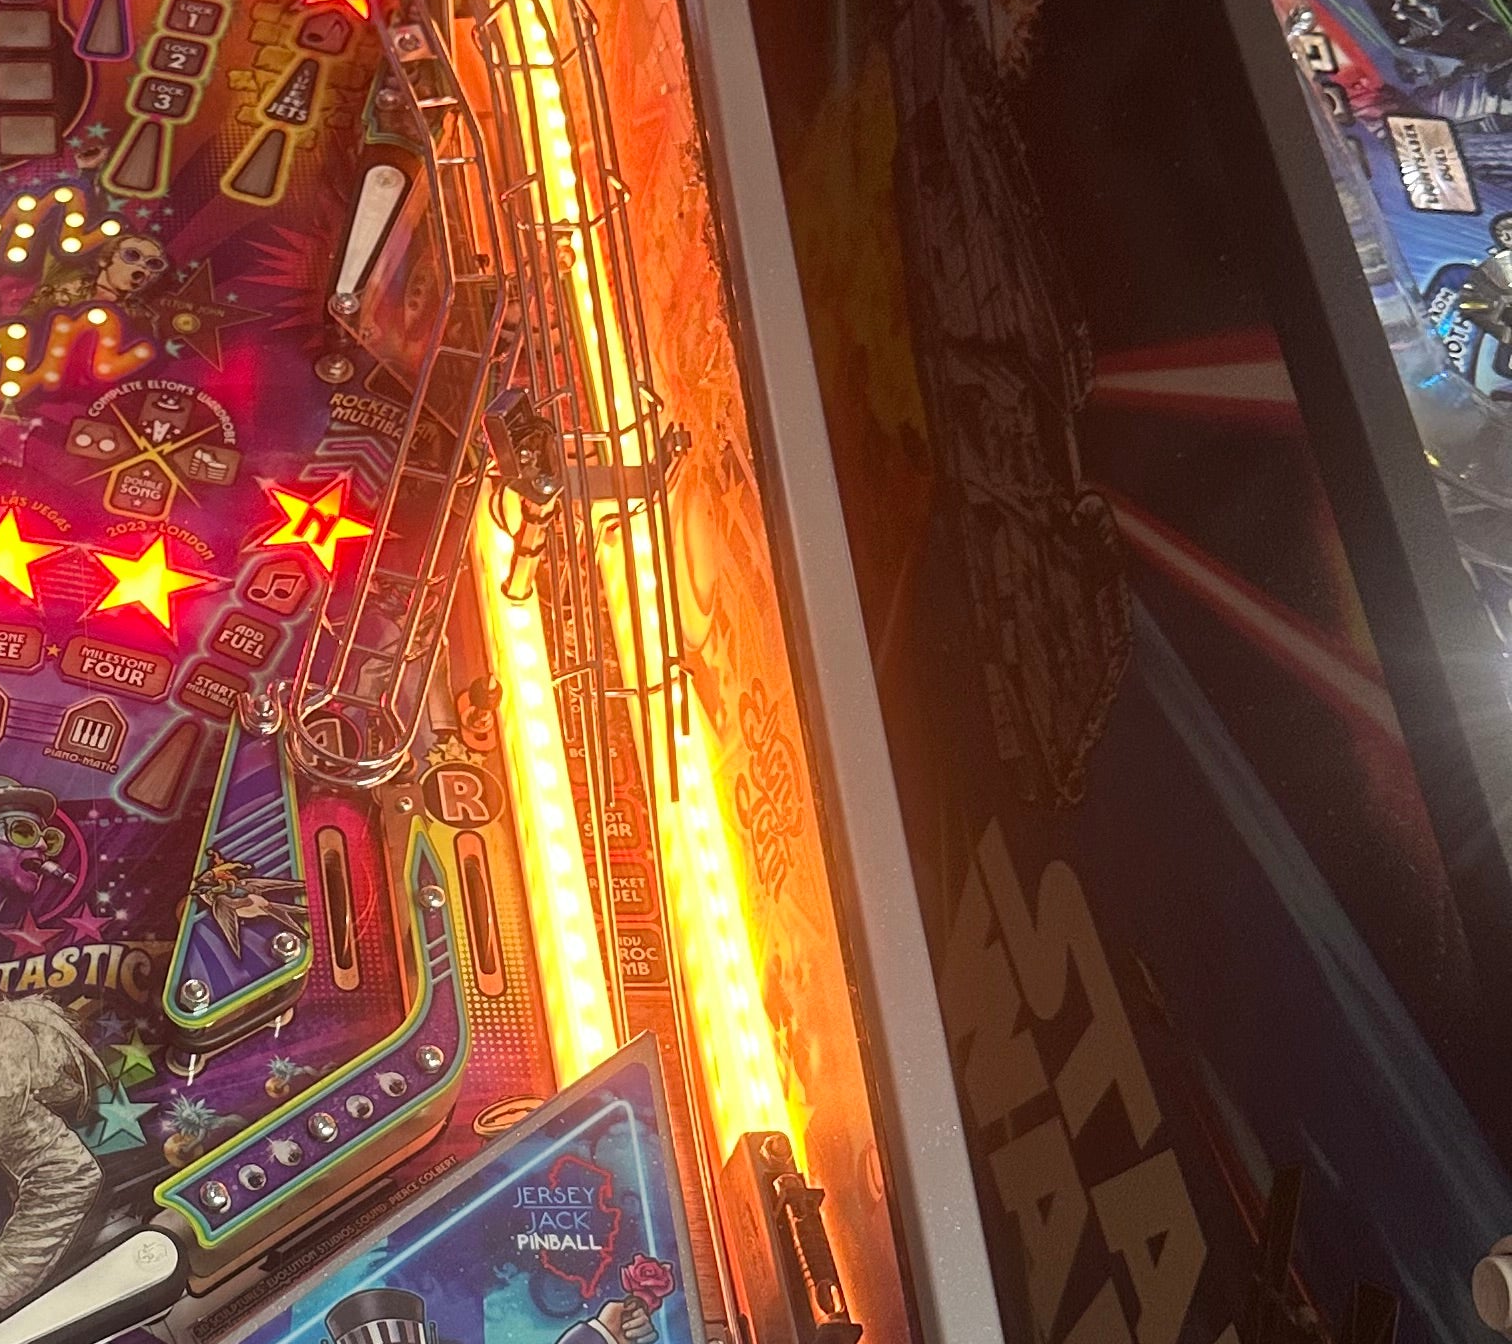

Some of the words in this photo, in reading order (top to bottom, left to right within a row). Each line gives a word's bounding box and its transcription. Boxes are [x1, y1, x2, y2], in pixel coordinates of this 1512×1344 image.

[180, 4, 213, 15] LOCK
[188, 13, 198, 28] 1
[164, 43, 198, 55] LOCK
[168, 53, 187, 69] 2
[150, 83, 184, 96] LOCK
[153, 94, 171, 110] 3
[266, 102, 308, 122] JETS
[88, 381, 143, 418] COMPLETE
[145, 378, 195, 398] ELTON'S
[196, 390, 237, 445] WARDROBE
[329, 393, 400, 420] ROCKET
[120, 483, 162, 501] SONG
[123, 476, 164, 491] DOUBLE
[0, 494, 26, 509] LAS
[29, 500, 73, 533] VEGAS
[105, 522, 148, 538] 2023
[156, 521, 216, 562] LONDON
[234, 624, 265, 642] ADD
[218, 629, 265, 659] FUEL
[80, 646, 155, 674] MILESTONE
[81, 659, 145, 687] FOUR
[194, 675, 238, 699] START
[43, 746, 119, 774] PIANO-MATIC
[436, 770, 491, 824] R
[513, 1186, 595, 1207] JERSEY
[526, 1210, 591, 1232] JACK
[517, 1233, 602, 1252] PINBALL
